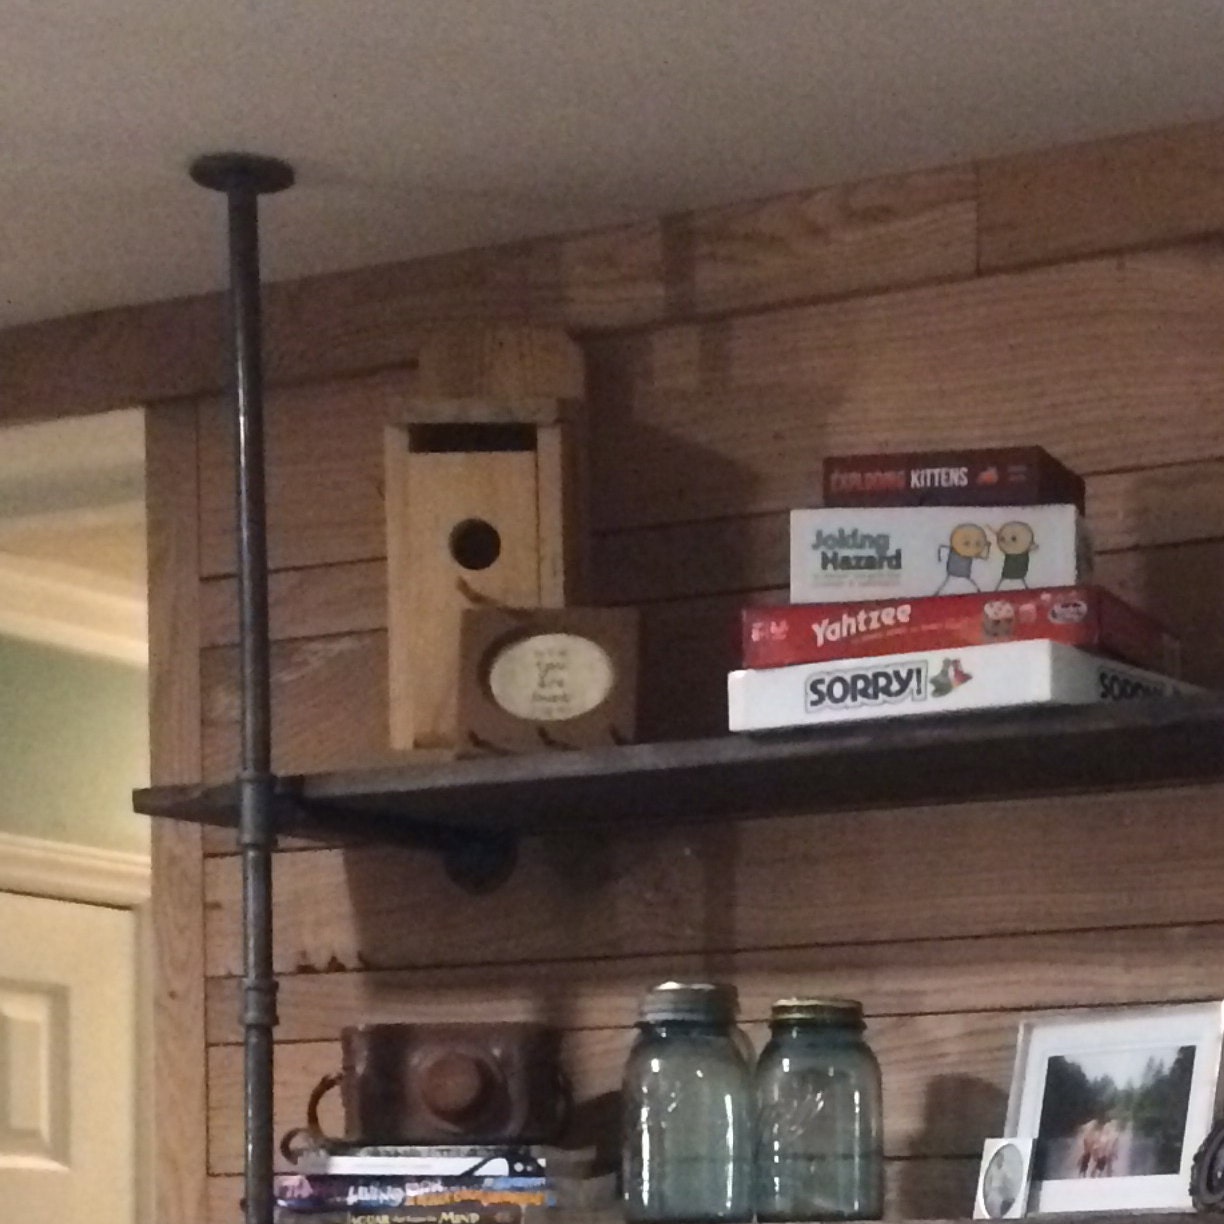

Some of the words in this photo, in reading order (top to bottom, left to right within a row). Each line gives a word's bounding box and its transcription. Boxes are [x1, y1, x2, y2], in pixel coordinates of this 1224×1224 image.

[910, 467, 968, 488] KITTENS
[811, 527, 890, 554] Joking
[821, 548, 902, 570] Hazard
[812, 603, 911, 647] Yahtzee
[808, 668, 923, 707] SORRY!
